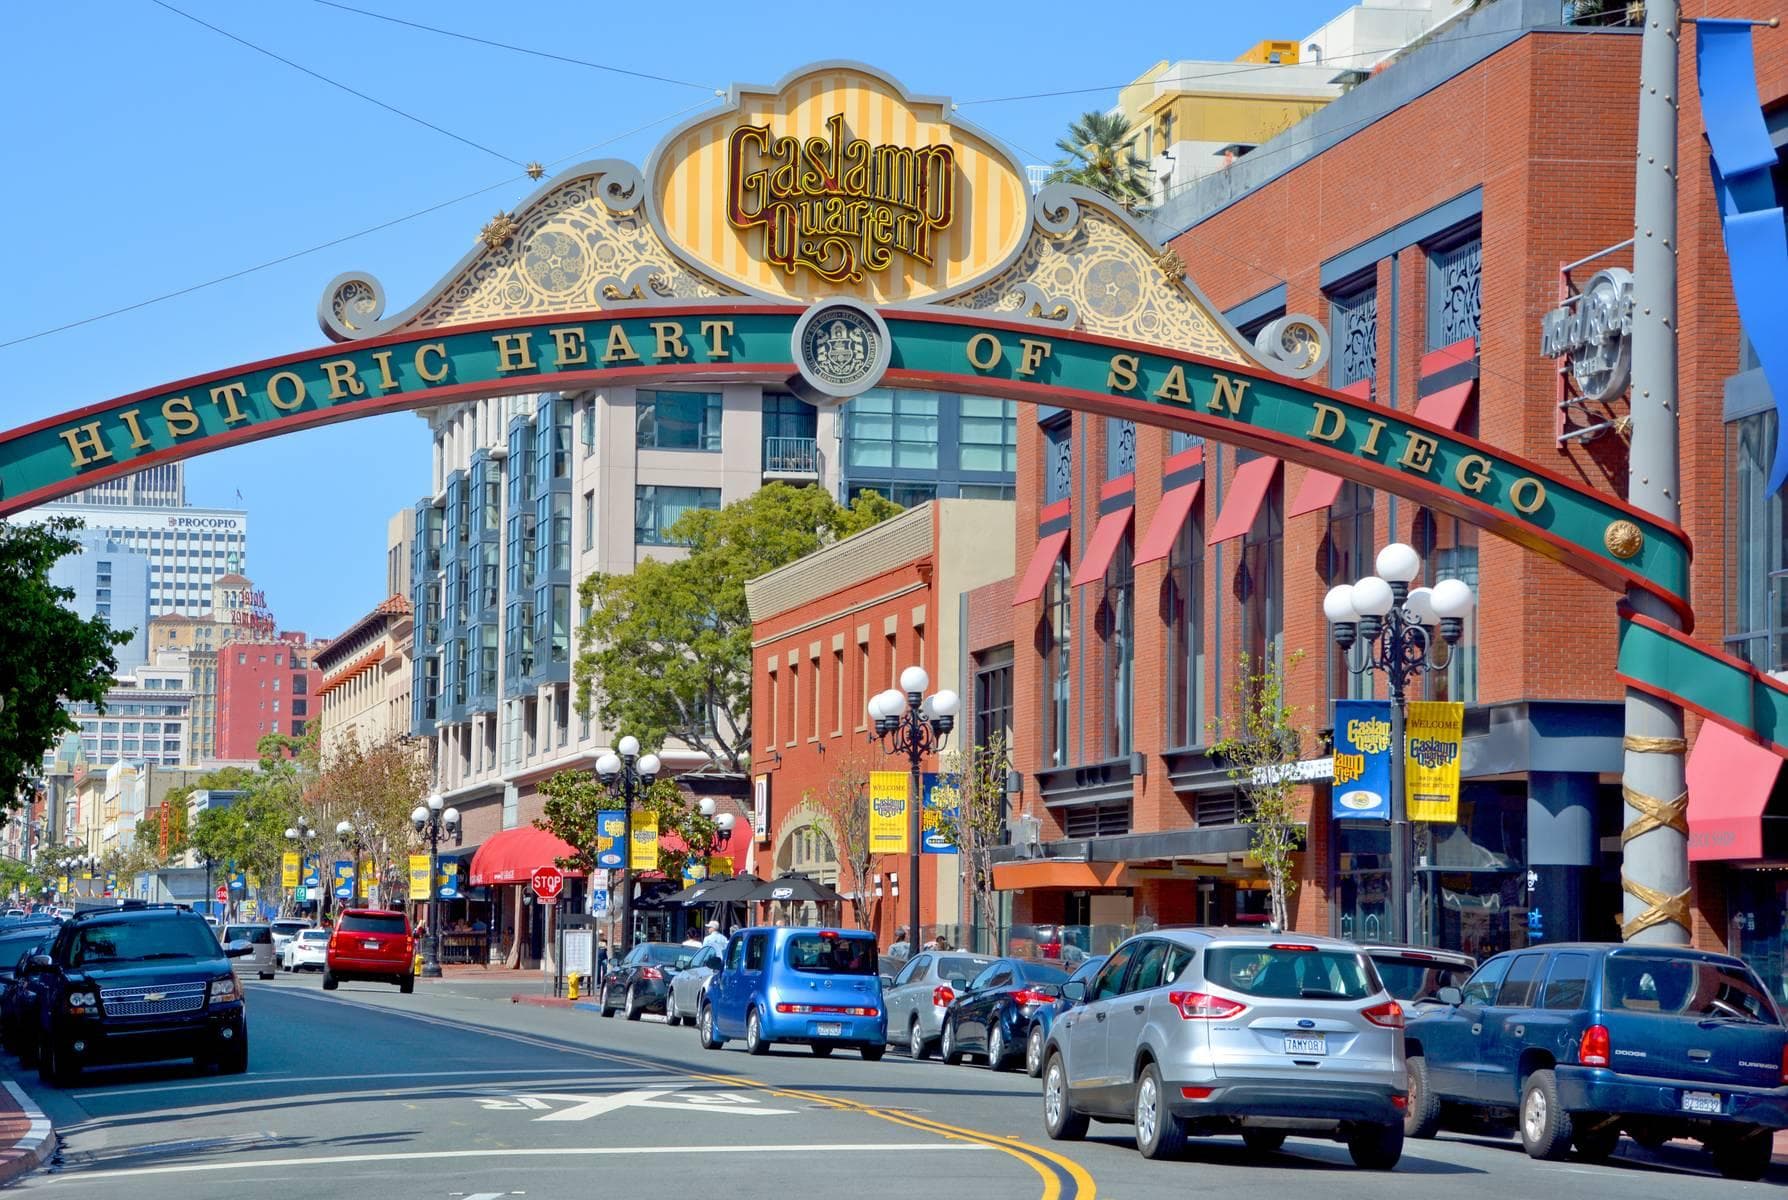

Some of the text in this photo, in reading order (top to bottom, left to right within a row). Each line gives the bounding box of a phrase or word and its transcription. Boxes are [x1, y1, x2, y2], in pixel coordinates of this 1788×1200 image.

[727, 112, 955, 267] Gaslamp
[763, 198, 920, 285] Quarter
[59, 320, 1546, 513] HISTORIC HEART OF SAN DIEGO
[178, 518, 236, 528] PROCOPIO
[1347, 716, 1391, 742] Gaslam
[1411, 719, 1459, 729] WELCOME
[1410, 736, 1457, 764] Gaslamp
[534, 876, 561, 888] STOP
[1738, 1060, 1778, 1070] DURANGO
